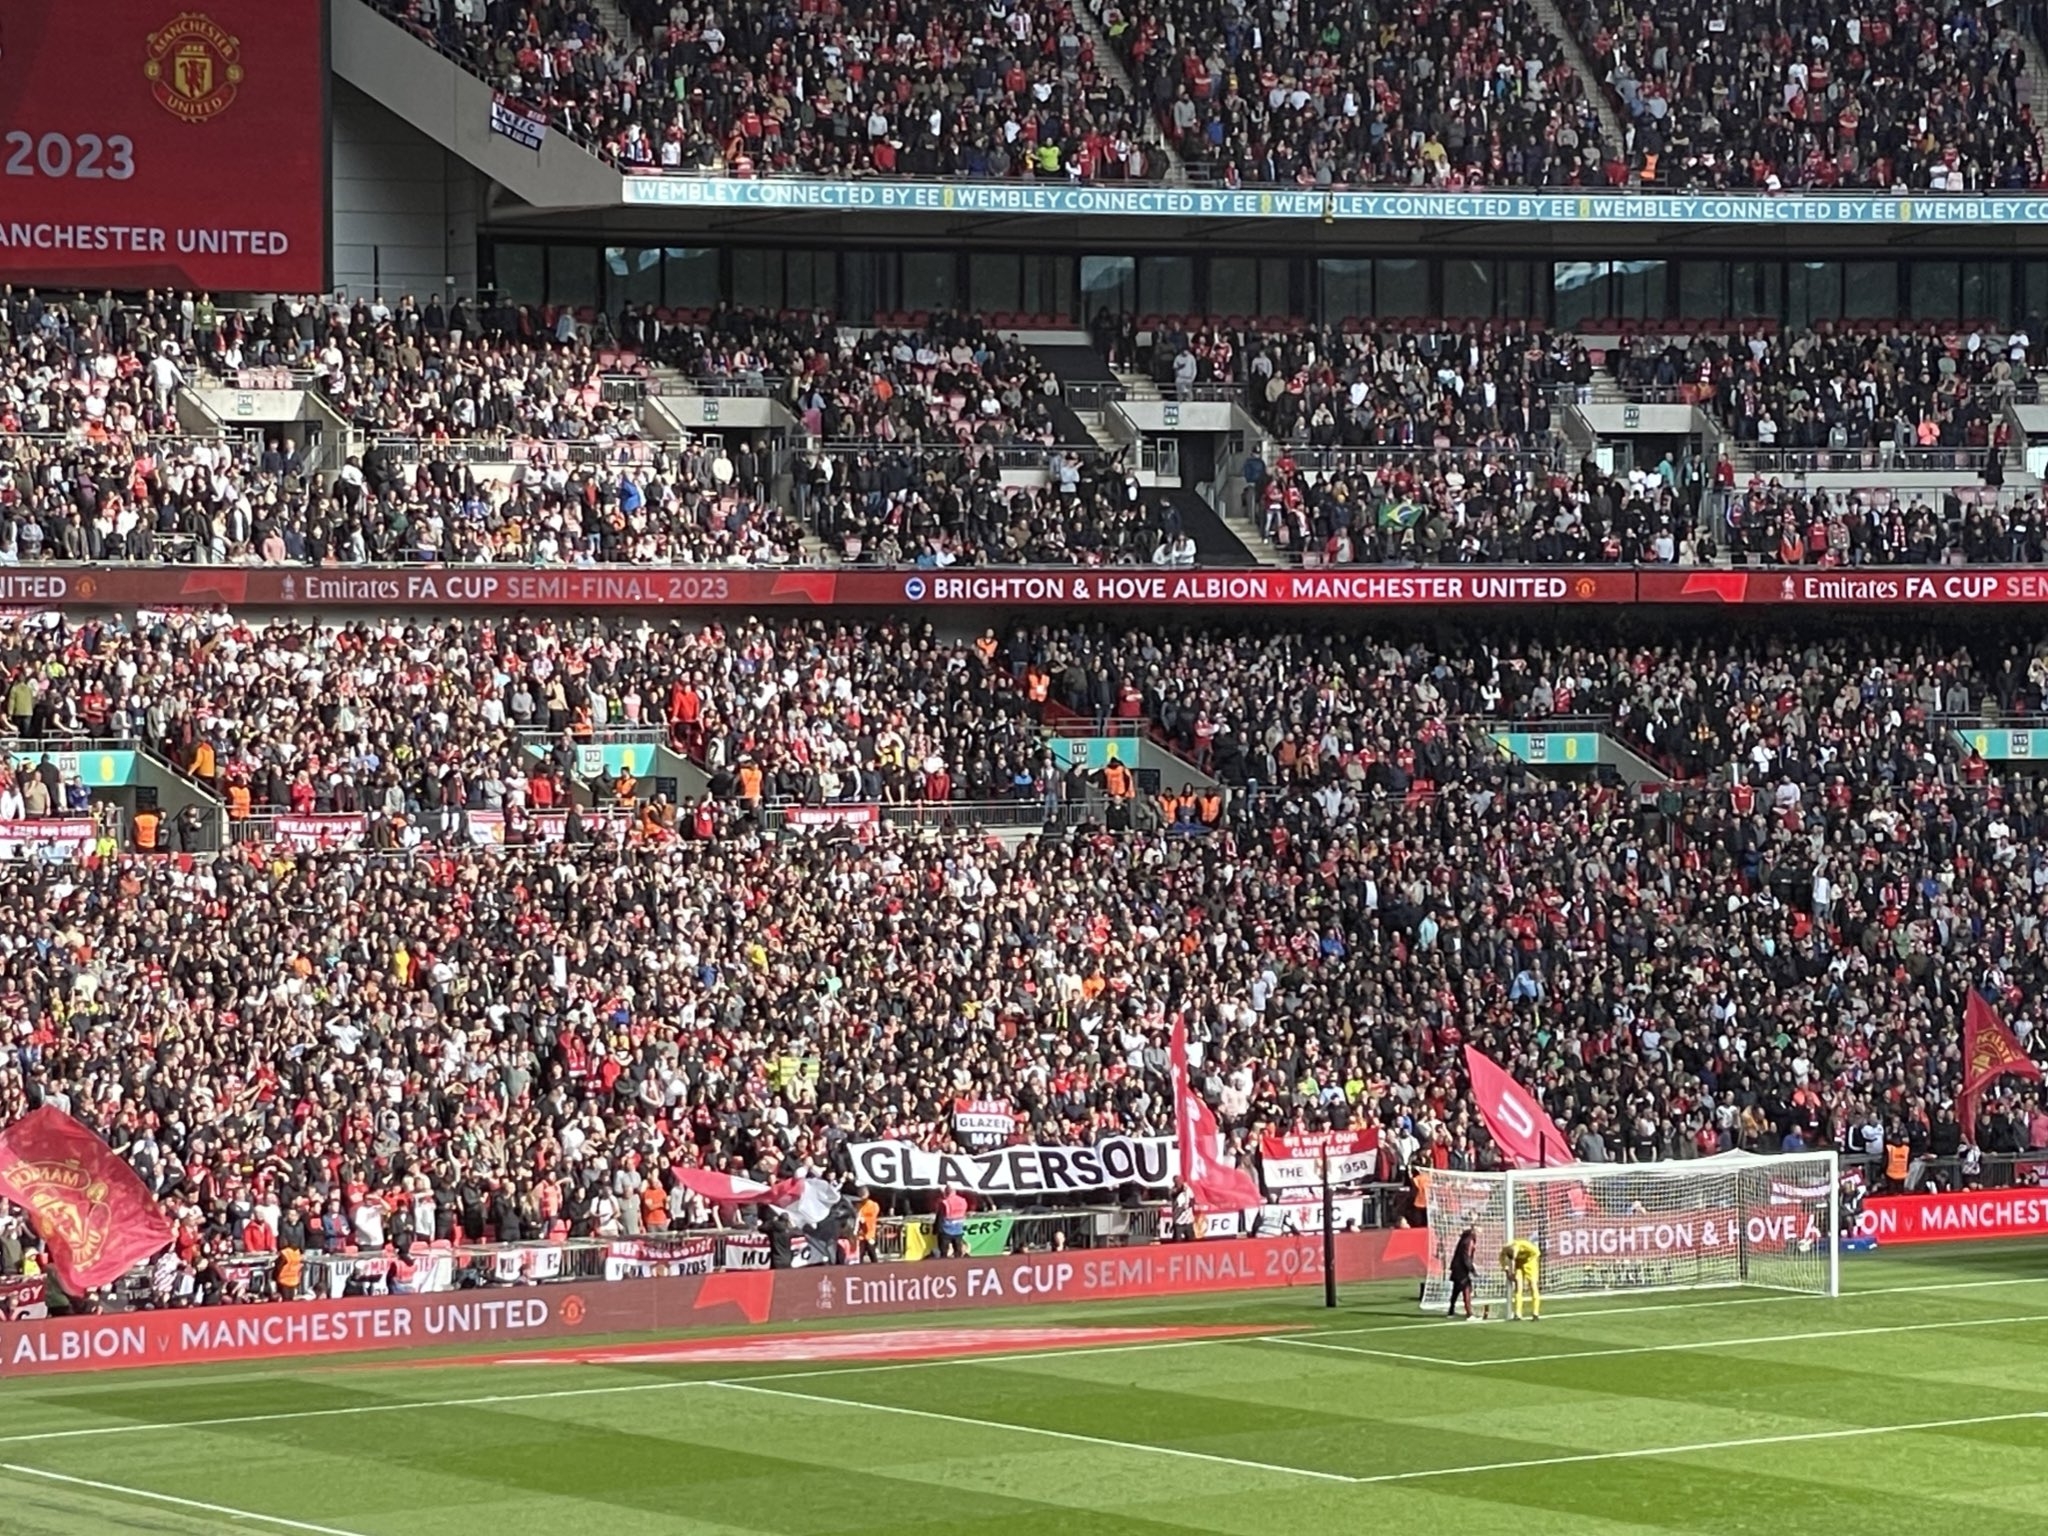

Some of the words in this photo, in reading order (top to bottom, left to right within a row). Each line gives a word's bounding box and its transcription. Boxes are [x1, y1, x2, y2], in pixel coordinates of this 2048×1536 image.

[153, 20, 234, 57] MANCHESTER
[166, 96, 223, 115] UNITED
[5, 130, 135, 180] 2023
[636, 182, 742, 202] WEMBLEY
[746, 184, 876, 205] CONNECTED
[882, 187, 910, 205] BY
[915, 188, 940, 206] EE
[957, 188, 1060, 209] WEMBLEY
[1064, 190, 1194, 212] CONNECTED
[1200, 193, 1228, 212] BY
[1233, 194, 1256, 213] EE
[1382, 196, 1511, 216] CONNECTED
[1518, 198, 1545, 217] BY
[1551, 198, 1575, 218] EE
[1593, 199, 1698, 218] WEMBLEY
[1701, 200, 1831, 219] CONNECTED
[1838, 201, 1866, 220] BY
[1870, 202, 1896, 220] EE
[1914, 201, 2021, 220] WEMBLEY
[176, 228, 289, 256] UNITED
[305, 575, 399, 599] Emirates
[407, 577, 438, 599] FA
[446, 577, 499, 599] CUP
[506, 577, 658, 600] SEMI-FINAL
[668, 577, 729, 599] 2023
[934, 577, 1064, 600] BRIGHTON
[1072, 578, 1091, 600] &
[1098, 578, 1166, 600] HOVE
[1173, 578, 1268, 600] ALBION
[1291, 577, 1463, 599] MANCHESTER
[1471, 577, 1567, 599] UNITED
[1804, 577, 1898, 600] Emirates
[1905, 577, 1937, 599] FA
[1943, 577, 1998, 599] CUP
[1530, 738, 1545, 750] 114
[968, 1100, 1008, 1114] JUST
[1301, 1134, 1333, 1146] WANT
[1335, 1131, 1359, 1144] OUR
[1291, 1146, 1320, 1158] CLUB
[1278, 1166, 1304, 1178] THE
[1338, 1159, 1368, 1175] 1958
[1211, 1217, 1231, 1231] FC
[1559, 1223, 1692, 1256] BRIGHTON
[1702, 1220, 1720, 1246] &
[845, 1272, 957, 1305] Emirates
[966, 1267, 1004, 1297] FA
[1012, 1263, 1073, 1294] CUP
[1083, 1251, 1254, 1289] SEMI-FINAL
[12, 1326, 146, 1364] ALBION
[181, 1308, 412, 1351] MANCHESTER
[424, 1298, 549, 1334] UNITED
